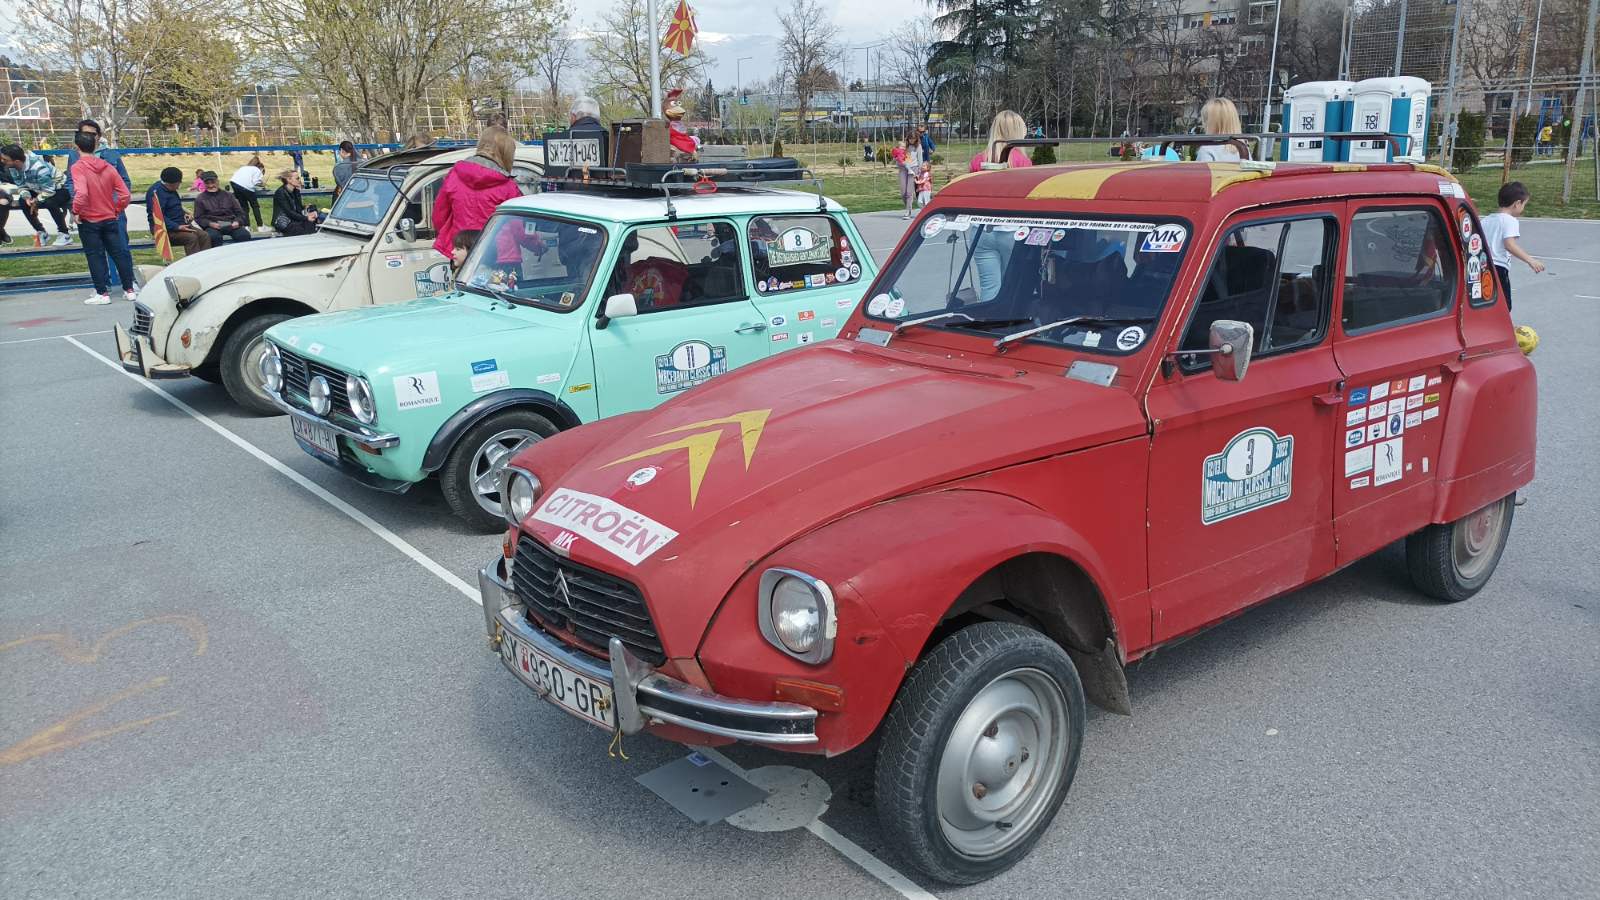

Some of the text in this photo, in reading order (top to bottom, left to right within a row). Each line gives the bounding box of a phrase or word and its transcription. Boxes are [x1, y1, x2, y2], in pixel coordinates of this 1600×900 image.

[1302, 113, 1316, 124] TOI
[1365, 113, 1379, 123] TOI
[795, 234, 802, 246] 8
[1149, 230, 1182, 242] MK
[442, 265, 450, 282] 2
[1469, 262, 1479, 273] MK
[686, 345, 695, 369] 11
[658, 369, 689, 385] MACEDONIA
[690, 365, 711, 380] CLASSIC
[399, 396, 440, 408] ROMANTIQUE
[1245, 438, 1255, 475] 3
[1205, 478, 1244, 508] MACEDONIA
[1244, 470, 1271, 497] CLASSIC
[1271, 456, 1290, 486] RALLY
[544, 493, 660, 556] CITROËN
[553, 530, 580, 550] MK
[502, 630, 607, 721] SK 930-GR
